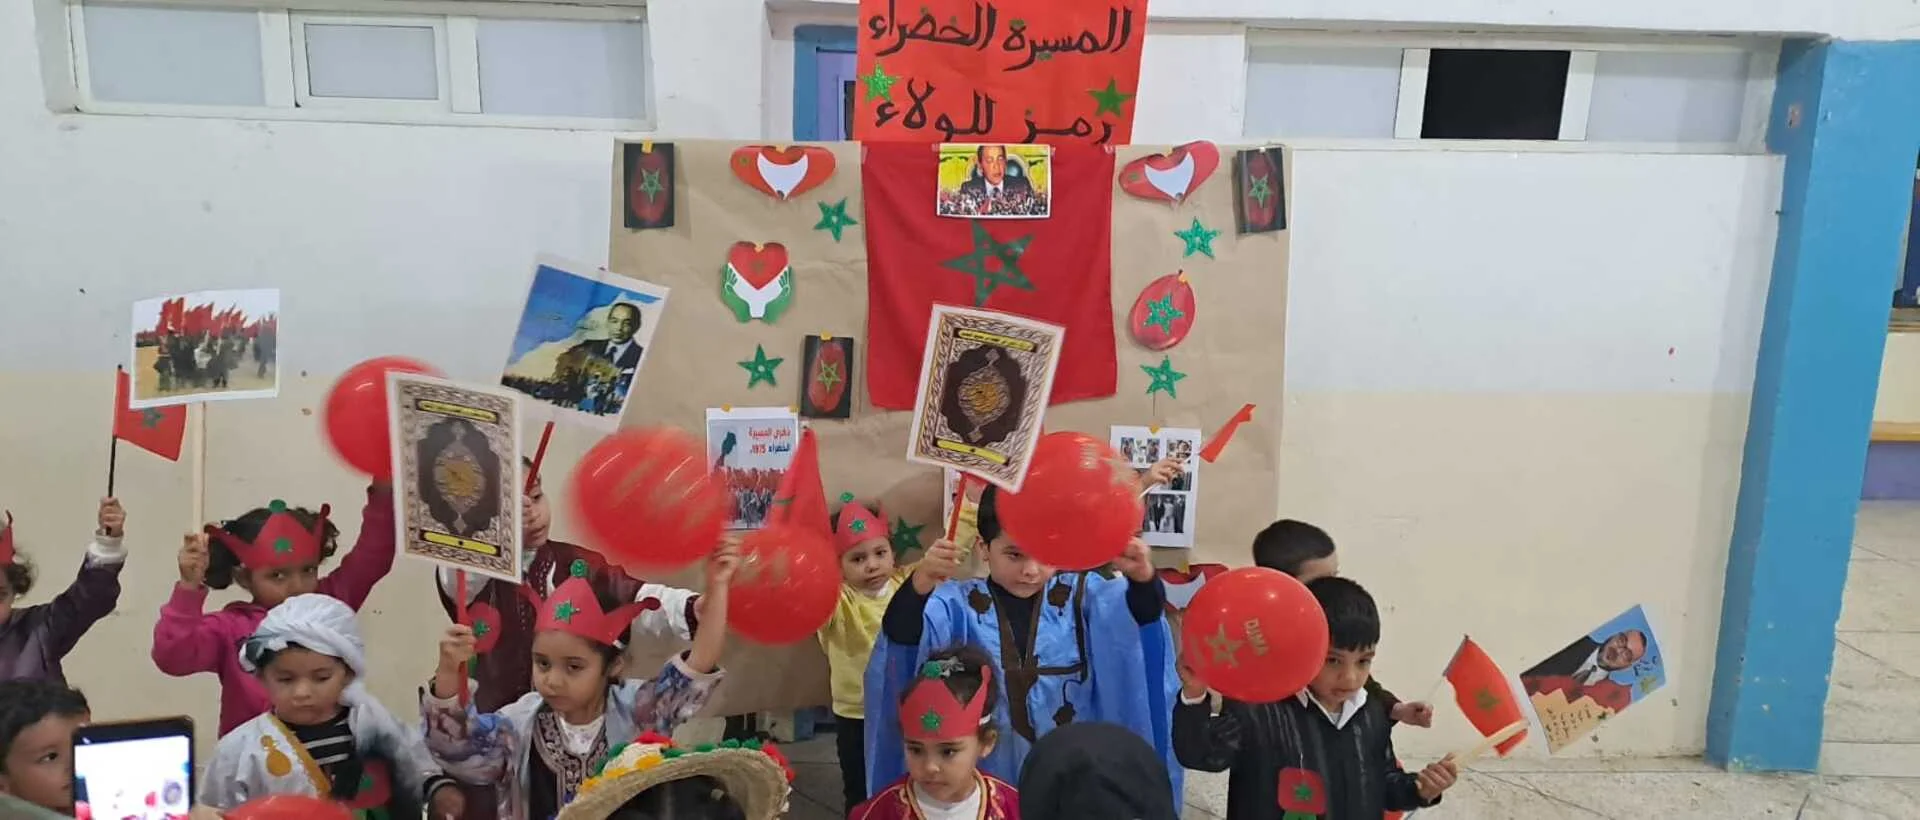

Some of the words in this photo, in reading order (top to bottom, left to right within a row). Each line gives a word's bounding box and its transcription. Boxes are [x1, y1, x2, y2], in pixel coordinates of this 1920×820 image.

[868, 0, 998, 57] الخضراء
[1002, 5, 1133, 72] المسيرة
[875, 77, 997, 143] للولاء
[1020, 108, 1116, 145] رمز
